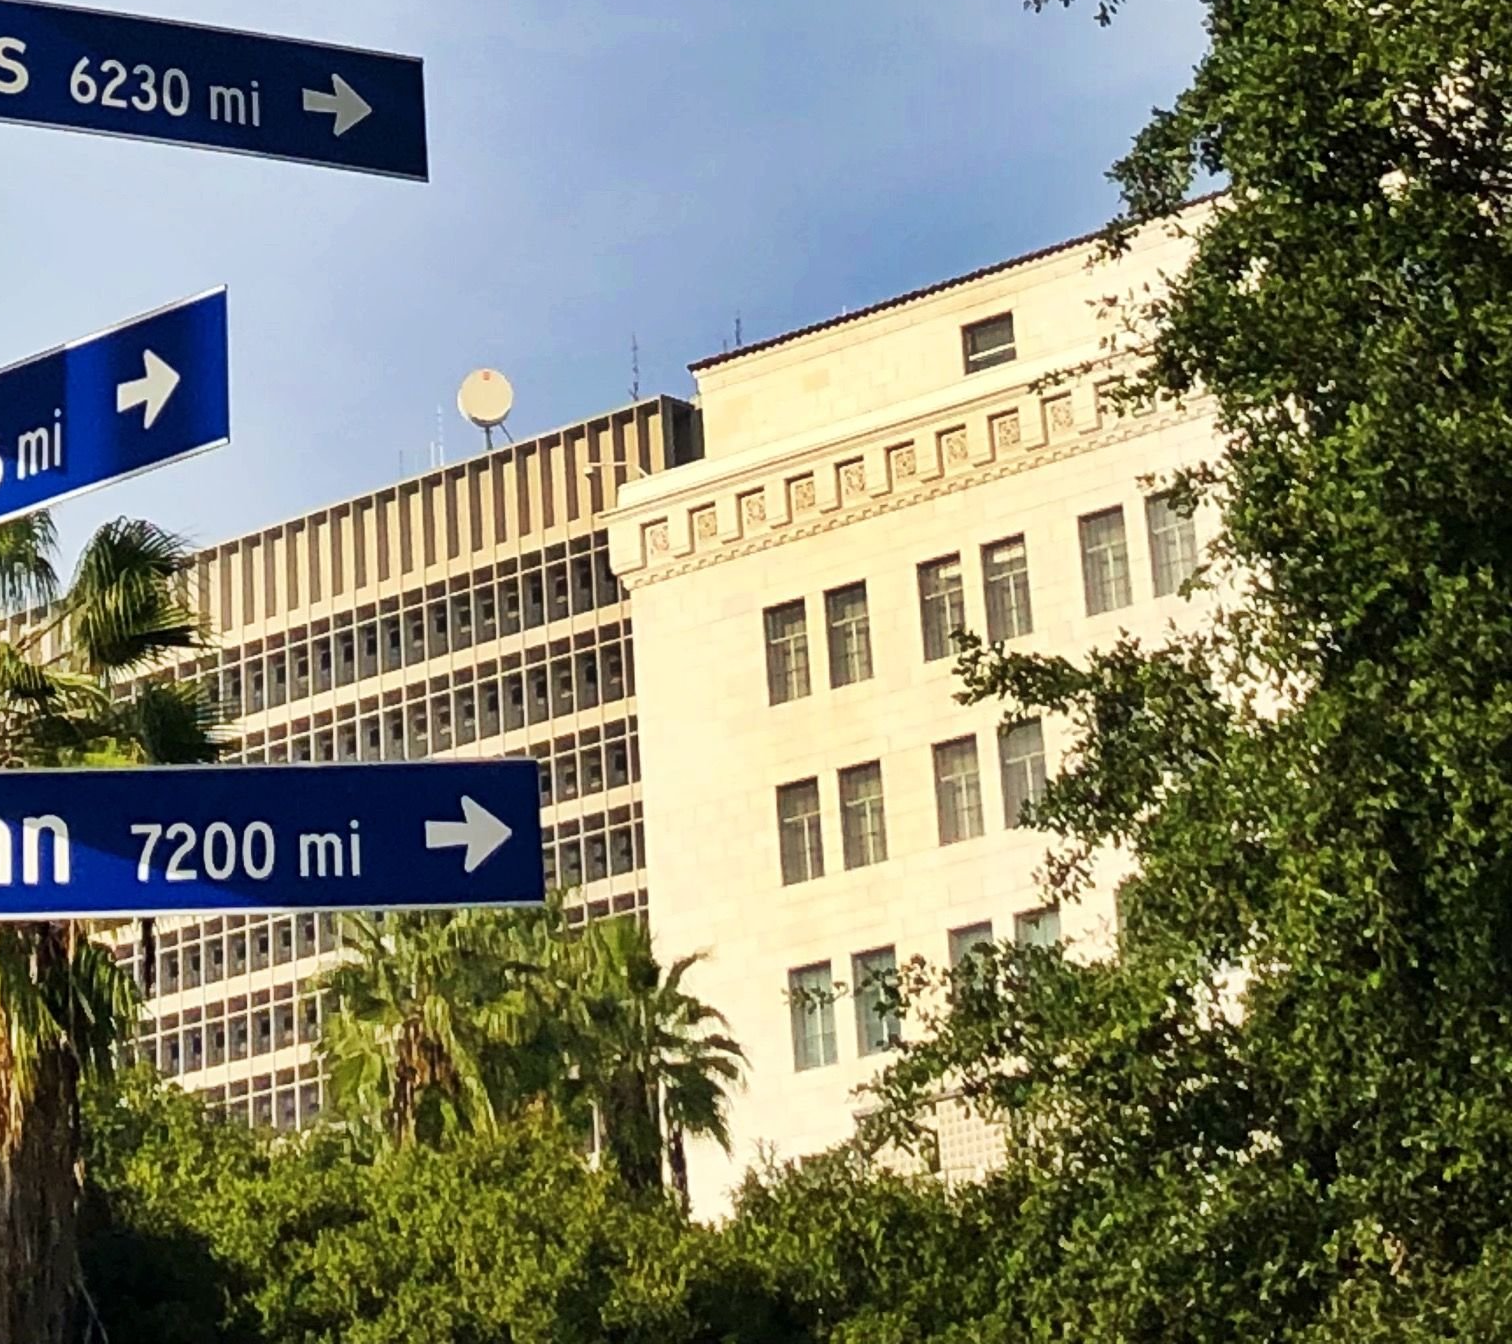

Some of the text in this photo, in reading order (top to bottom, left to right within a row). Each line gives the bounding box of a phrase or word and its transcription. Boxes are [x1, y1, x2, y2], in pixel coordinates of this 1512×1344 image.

[69, 57, 191, 117] 6230
[209, 80, 262, 127] mi
[16, 409, 62, 481] mi
[130, 821, 275, 883] 7200
[299, 819, 361, 878] mi
